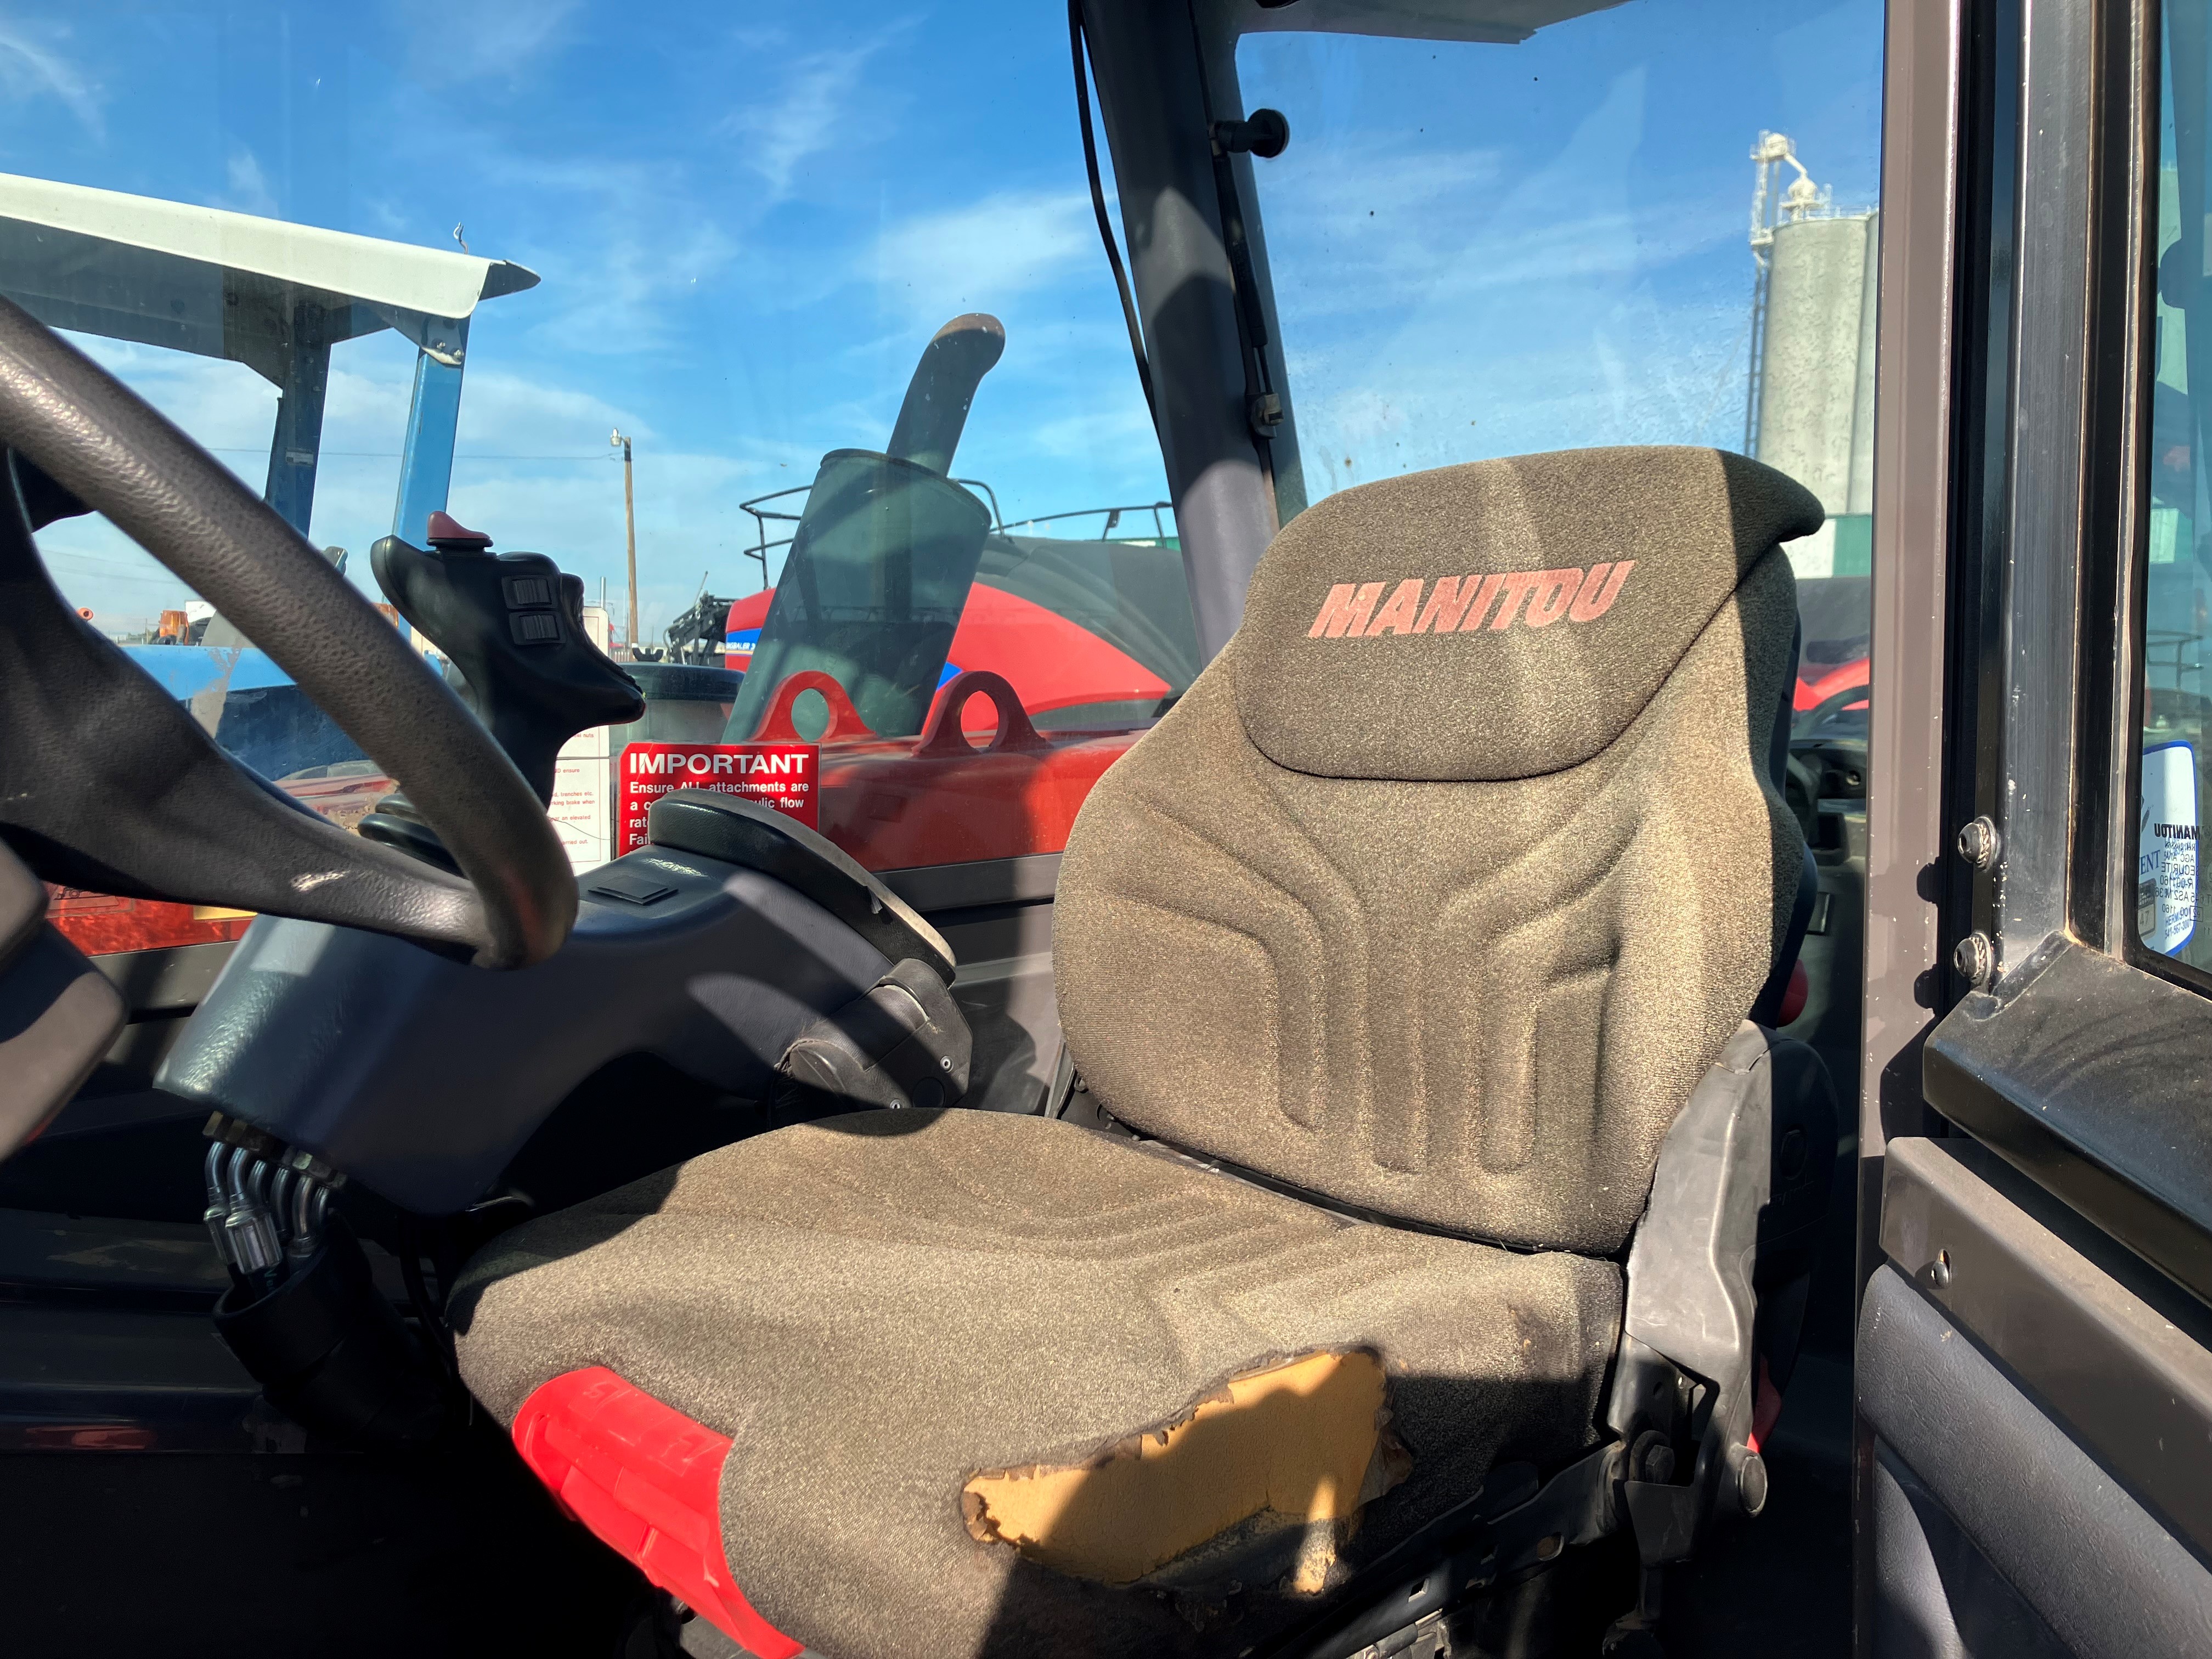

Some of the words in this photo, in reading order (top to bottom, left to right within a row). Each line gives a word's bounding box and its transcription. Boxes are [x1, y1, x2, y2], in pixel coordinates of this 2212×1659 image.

[1308, 560, 1638, 637] MANITOU
[630, 753, 809, 775] IMPORTANT
[630, 781, 674, 793] Ensure
[709, 781, 786, 793] attachments
[791, 783, 809, 792] are
[630, 802, 638, 811] a
[781, 797, 804, 808] flow
[629, 816, 648, 828] rat
